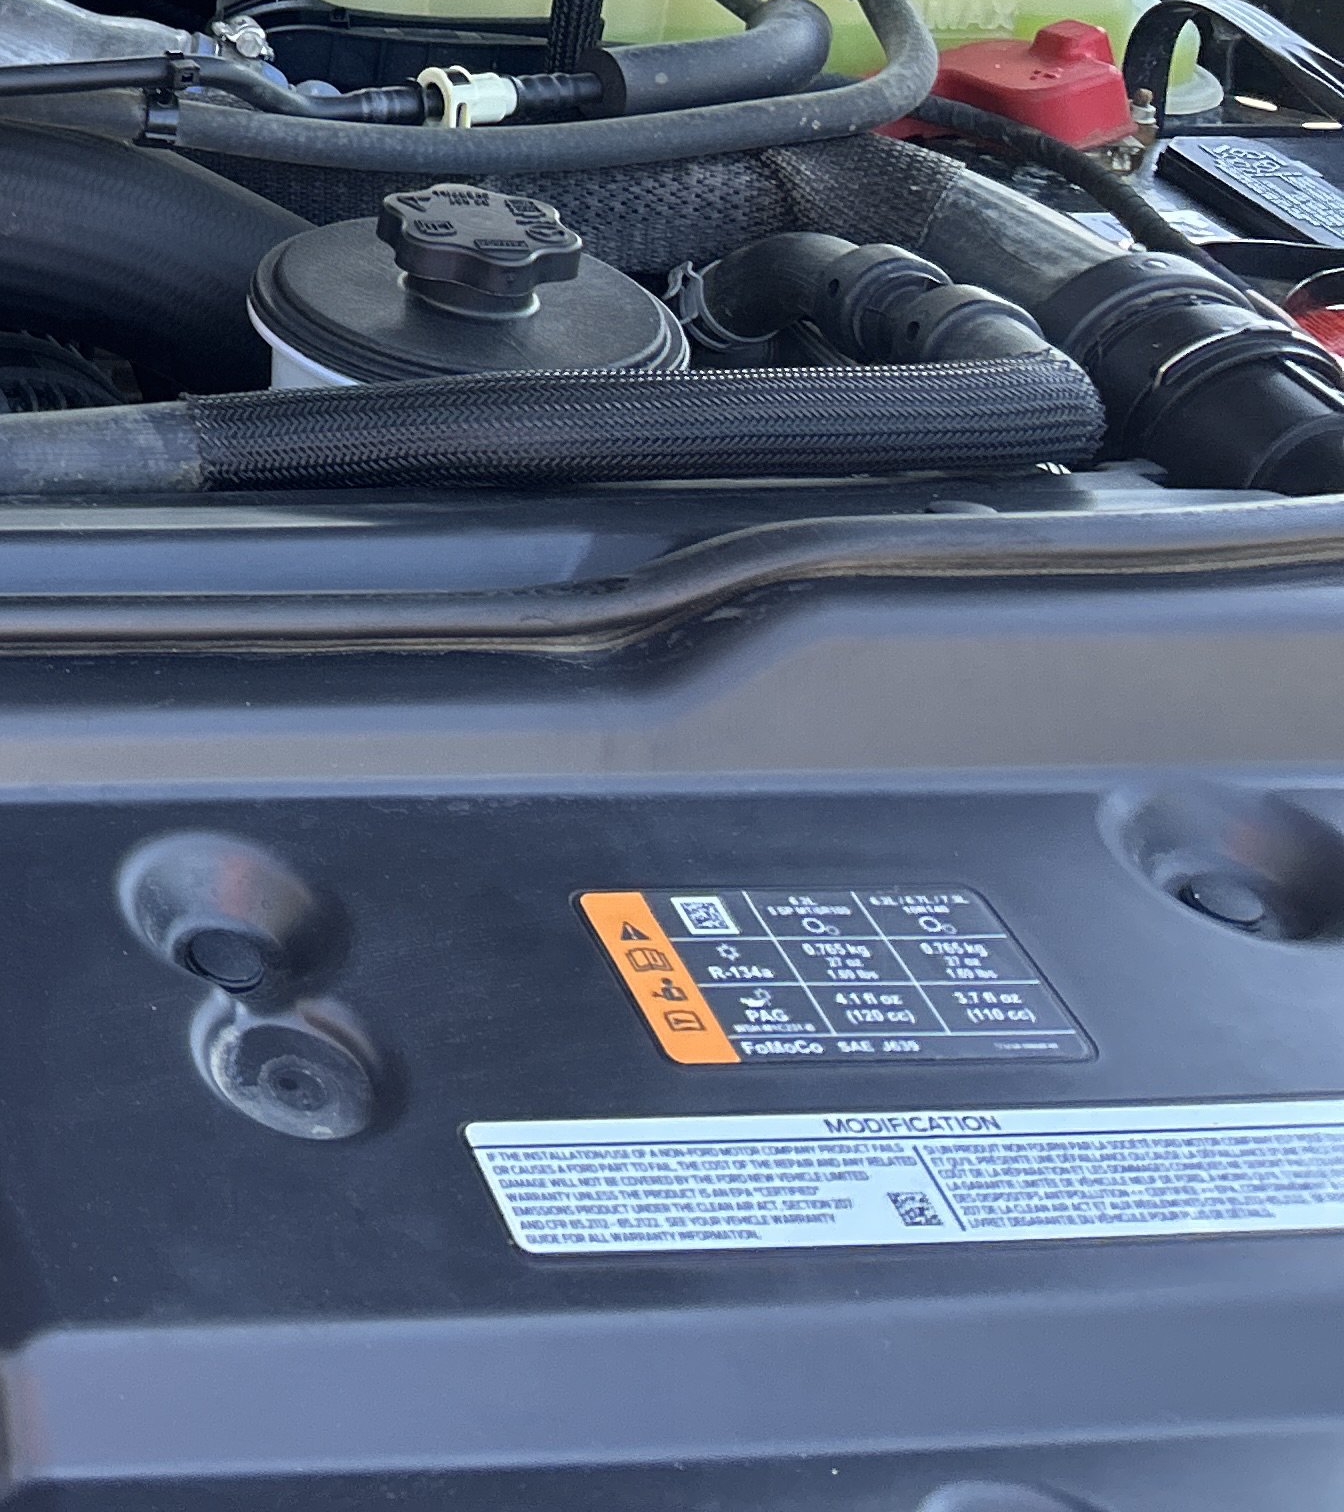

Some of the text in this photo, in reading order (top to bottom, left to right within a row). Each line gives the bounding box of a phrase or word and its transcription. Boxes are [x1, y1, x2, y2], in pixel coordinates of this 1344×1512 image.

[846, 943, 872, 958] kg
[963, 942, 989, 958] kg
[707, 965, 775, 980] R-134a
[835, 992, 862, 1006] 4.1
[879, 993, 904, 1006] oz
[952, 991, 980, 1005] 3.7
[999, 993, 1023, 1005] oz
[744, 1008, 790, 1023] PAG
[846, 1008, 916, 1025] (120 cc)
[966, 1007, 1037, 1024] (110 cc)
[741, 1039, 825, 1056] FoMoCo
[837, 1039, 875, 1054] SAE
[823, 1115, 1002, 1134] MODIFICATION
[497, 1151, 522, 1162] THE
[717, 1144, 761, 1156] MOTOR
[758, 1143, 817, 1155] COMPANY
[815, 1141, 870, 1153] PRODUCT
[869, 1140, 905, 1152] FAILS
[491, 1165, 511, 1176] OR
[509, 1163, 557, 1176] CAUSES
[564, 1162, 599, 1174] FORD
[596, 1161, 631, 1173] PART
[629, 1161, 649, 1172] TO
[675, 1159, 701, 1171] THE
[699, 1159, 732, 1170] COST
[748, 1158, 773, 1169] THE
[771, 1156, 816, 1168] REPAIR
[813, 1156, 841, 1167] AND
[839, 1155, 866, 1167] ANY
[863, 1154, 918, 1166] RELATED
[497, 1177, 549, 1190] DAMAGE
[547, 1176, 578, 1189] WILL
[576, 1176, 604, 1188] NOT
[618, 1174, 675, 1187] COVERED
[672, 1173, 692, 1185] BY
[690, 1173, 715, 1185] THE
[713, 1172, 748, 1184] FORD
[745, 1171, 776, 1183] NEW
[774, 1170, 823, 1183] VEHICLE
[821, 1168, 870, 1181] LIMITED
[504, 1190, 573, 1203] WARRANTY
[570, 1189, 619, 1202] UNLESS
[617, 1188, 642, 1200] THE
[641, 1187, 698, 1200] PRODUCT
[727, 1185, 754, 1197] EPA
[511, 1204, 576, 1218] EMISSIONS
[573, 1202, 631, 1216] PRODUCT
[629, 1201, 672, 1214] UNDER
[670, 1201, 694, 1213] THE
[693, 1200, 735, 1213] CLEAN
[732, 1199, 756, 1211] AIR
[780, 1197, 832, 1210] SECTION
[517, 1219, 546, 1231] AND
[687, 1214, 723, 1227] YOUR
[721, 1213, 770, 1226] VEHICLE
[769, 1211, 837, 1225] WARRANTY
[524, 1233, 562, 1245] GUIDE
[560, 1232, 588, 1244] FOR
[585, 1231, 609, 1243] ALL
[608, 1230, 678, 1243] WARRANTY
